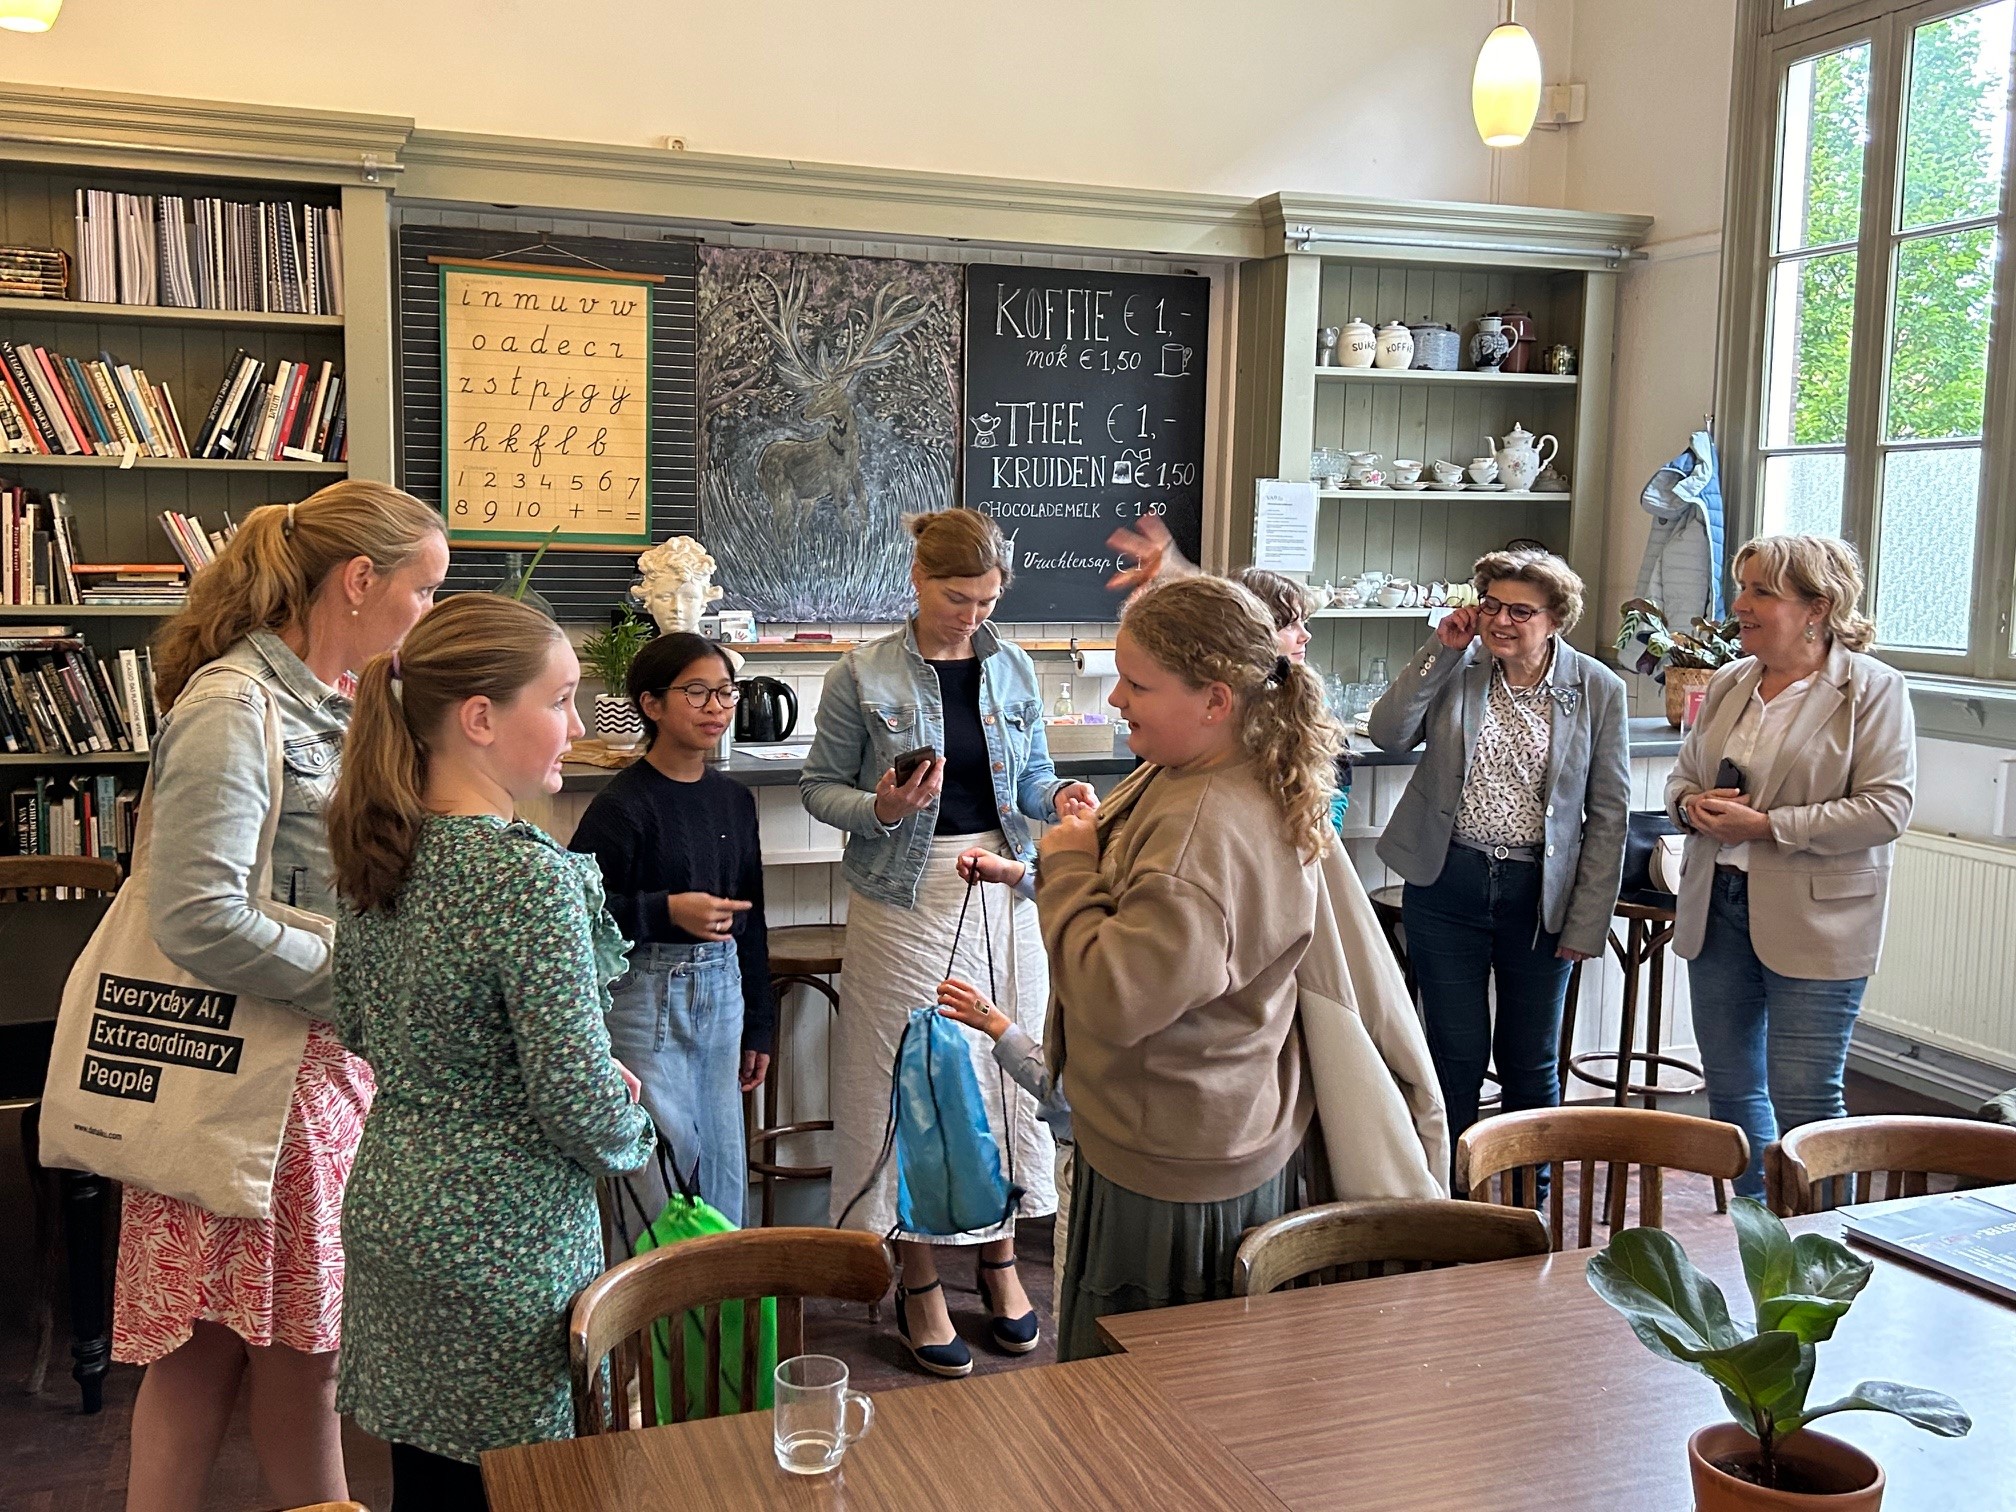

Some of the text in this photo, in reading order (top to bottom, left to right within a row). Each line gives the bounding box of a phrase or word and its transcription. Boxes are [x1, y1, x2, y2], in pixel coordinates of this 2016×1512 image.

[995, 282, 1113, 342] KOFFIE
[1123, 294, 1141, 336] €
[1026, 343, 1142, 375] mok € 1,50
[995, 401, 1084, 447] THEE
[1106, 403, 1124, 444] €
[992, 455, 1196, 491] KRUIDEN € 1,50
[977, 500, 1101, 518] CHOCOLADEMELK
[1023, 551, 1111, 574] Vruchtensap
[102, 979, 225, 1025] Everyday AI,
[94, 1019, 235, 1068] Extraordinary
[86, 1060, 154, 1094] People
